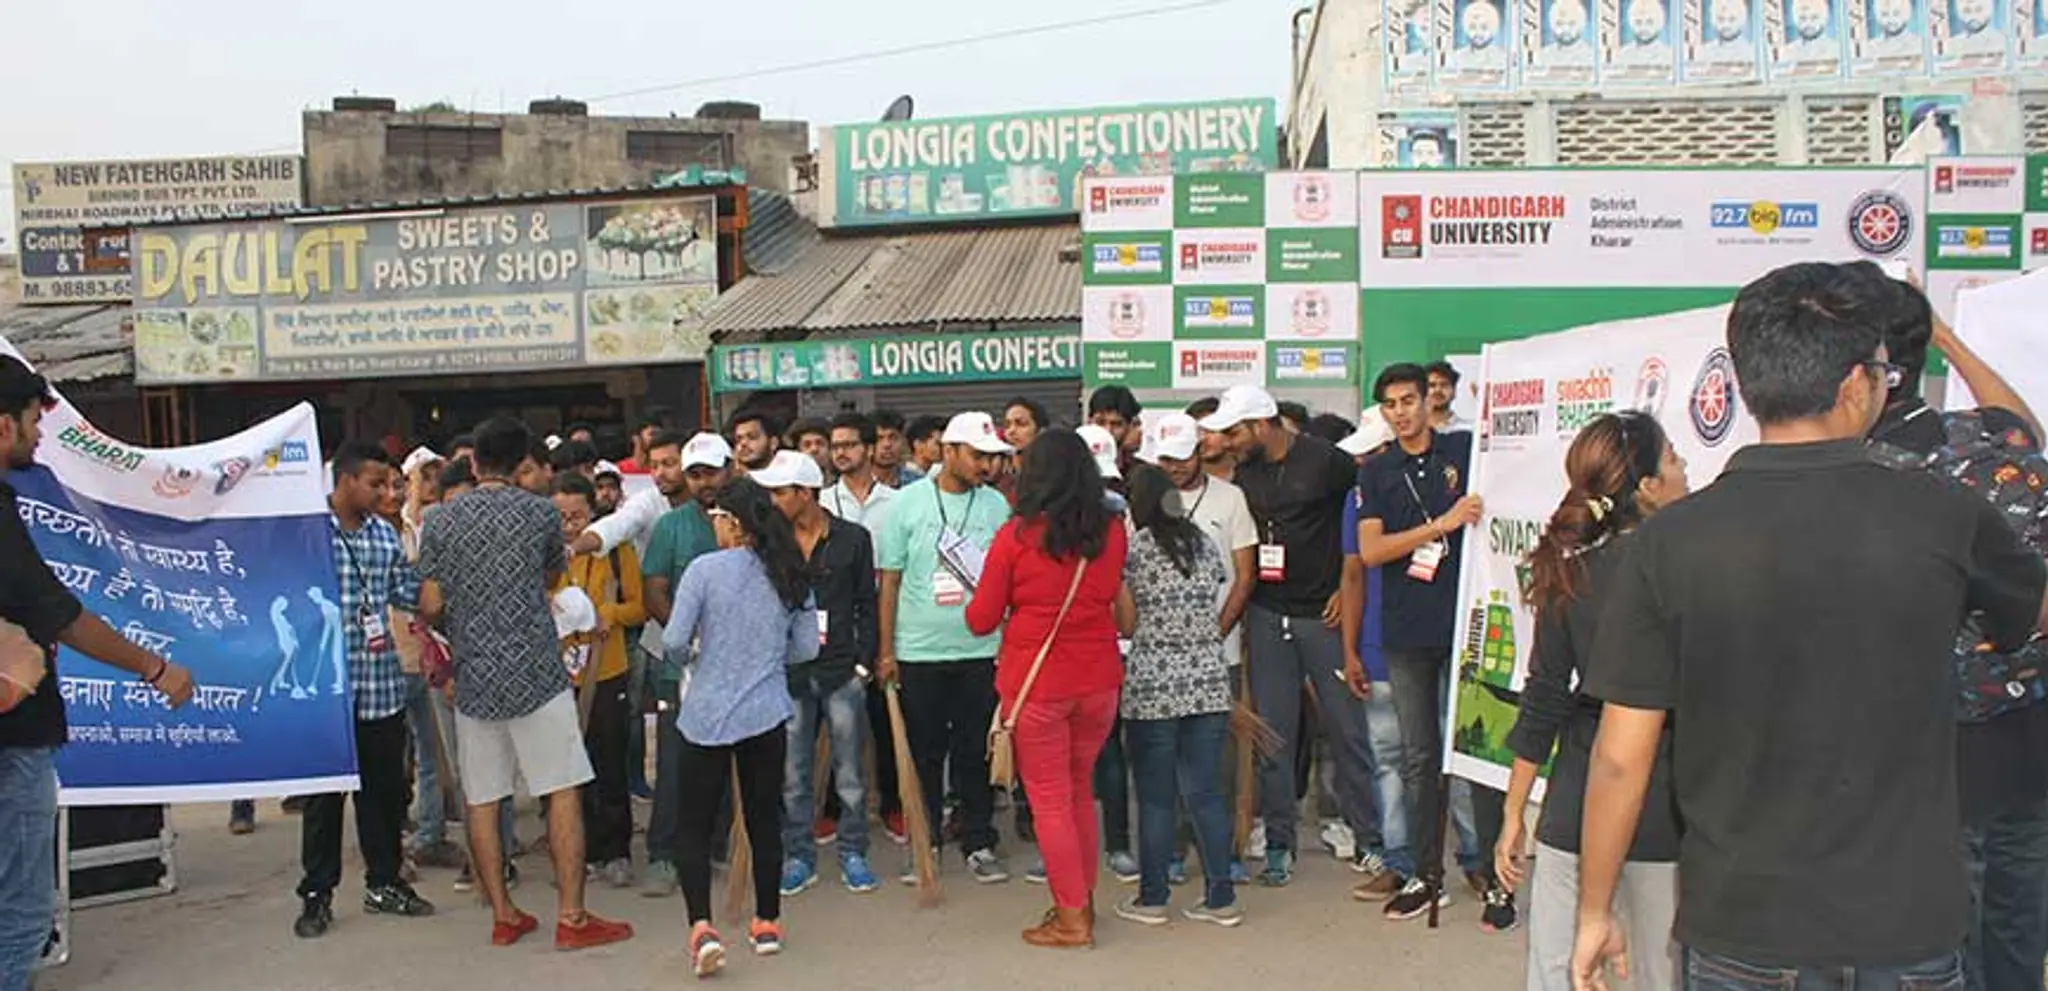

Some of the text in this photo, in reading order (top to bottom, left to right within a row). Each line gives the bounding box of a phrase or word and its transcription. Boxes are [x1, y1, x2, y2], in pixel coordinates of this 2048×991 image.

[850, 105, 1263, 170] LONGIA CONFECTIONERY
[54, 158, 295, 187] NEW FATEHGARH SAHIB
[1429, 194, 1565, 219] CHANDIGARH
[1590, 195, 1638, 211] District
[1712, 206, 1747, 225] 92.7
[1784, 206, 1815, 225] fm
[398, 211, 550, 250] SWEETS &
[1430, 221, 1553, 245] UNIVERSITY
[141, 225, 368, 305] DAULAT
[373, 248, 579, 290] PASTRY SHOP
[869, 340, 962, 376] LONGIA
[1492, 410, 1539, 436] UNIVERSITY
[141, 579, 165, 612] तो
